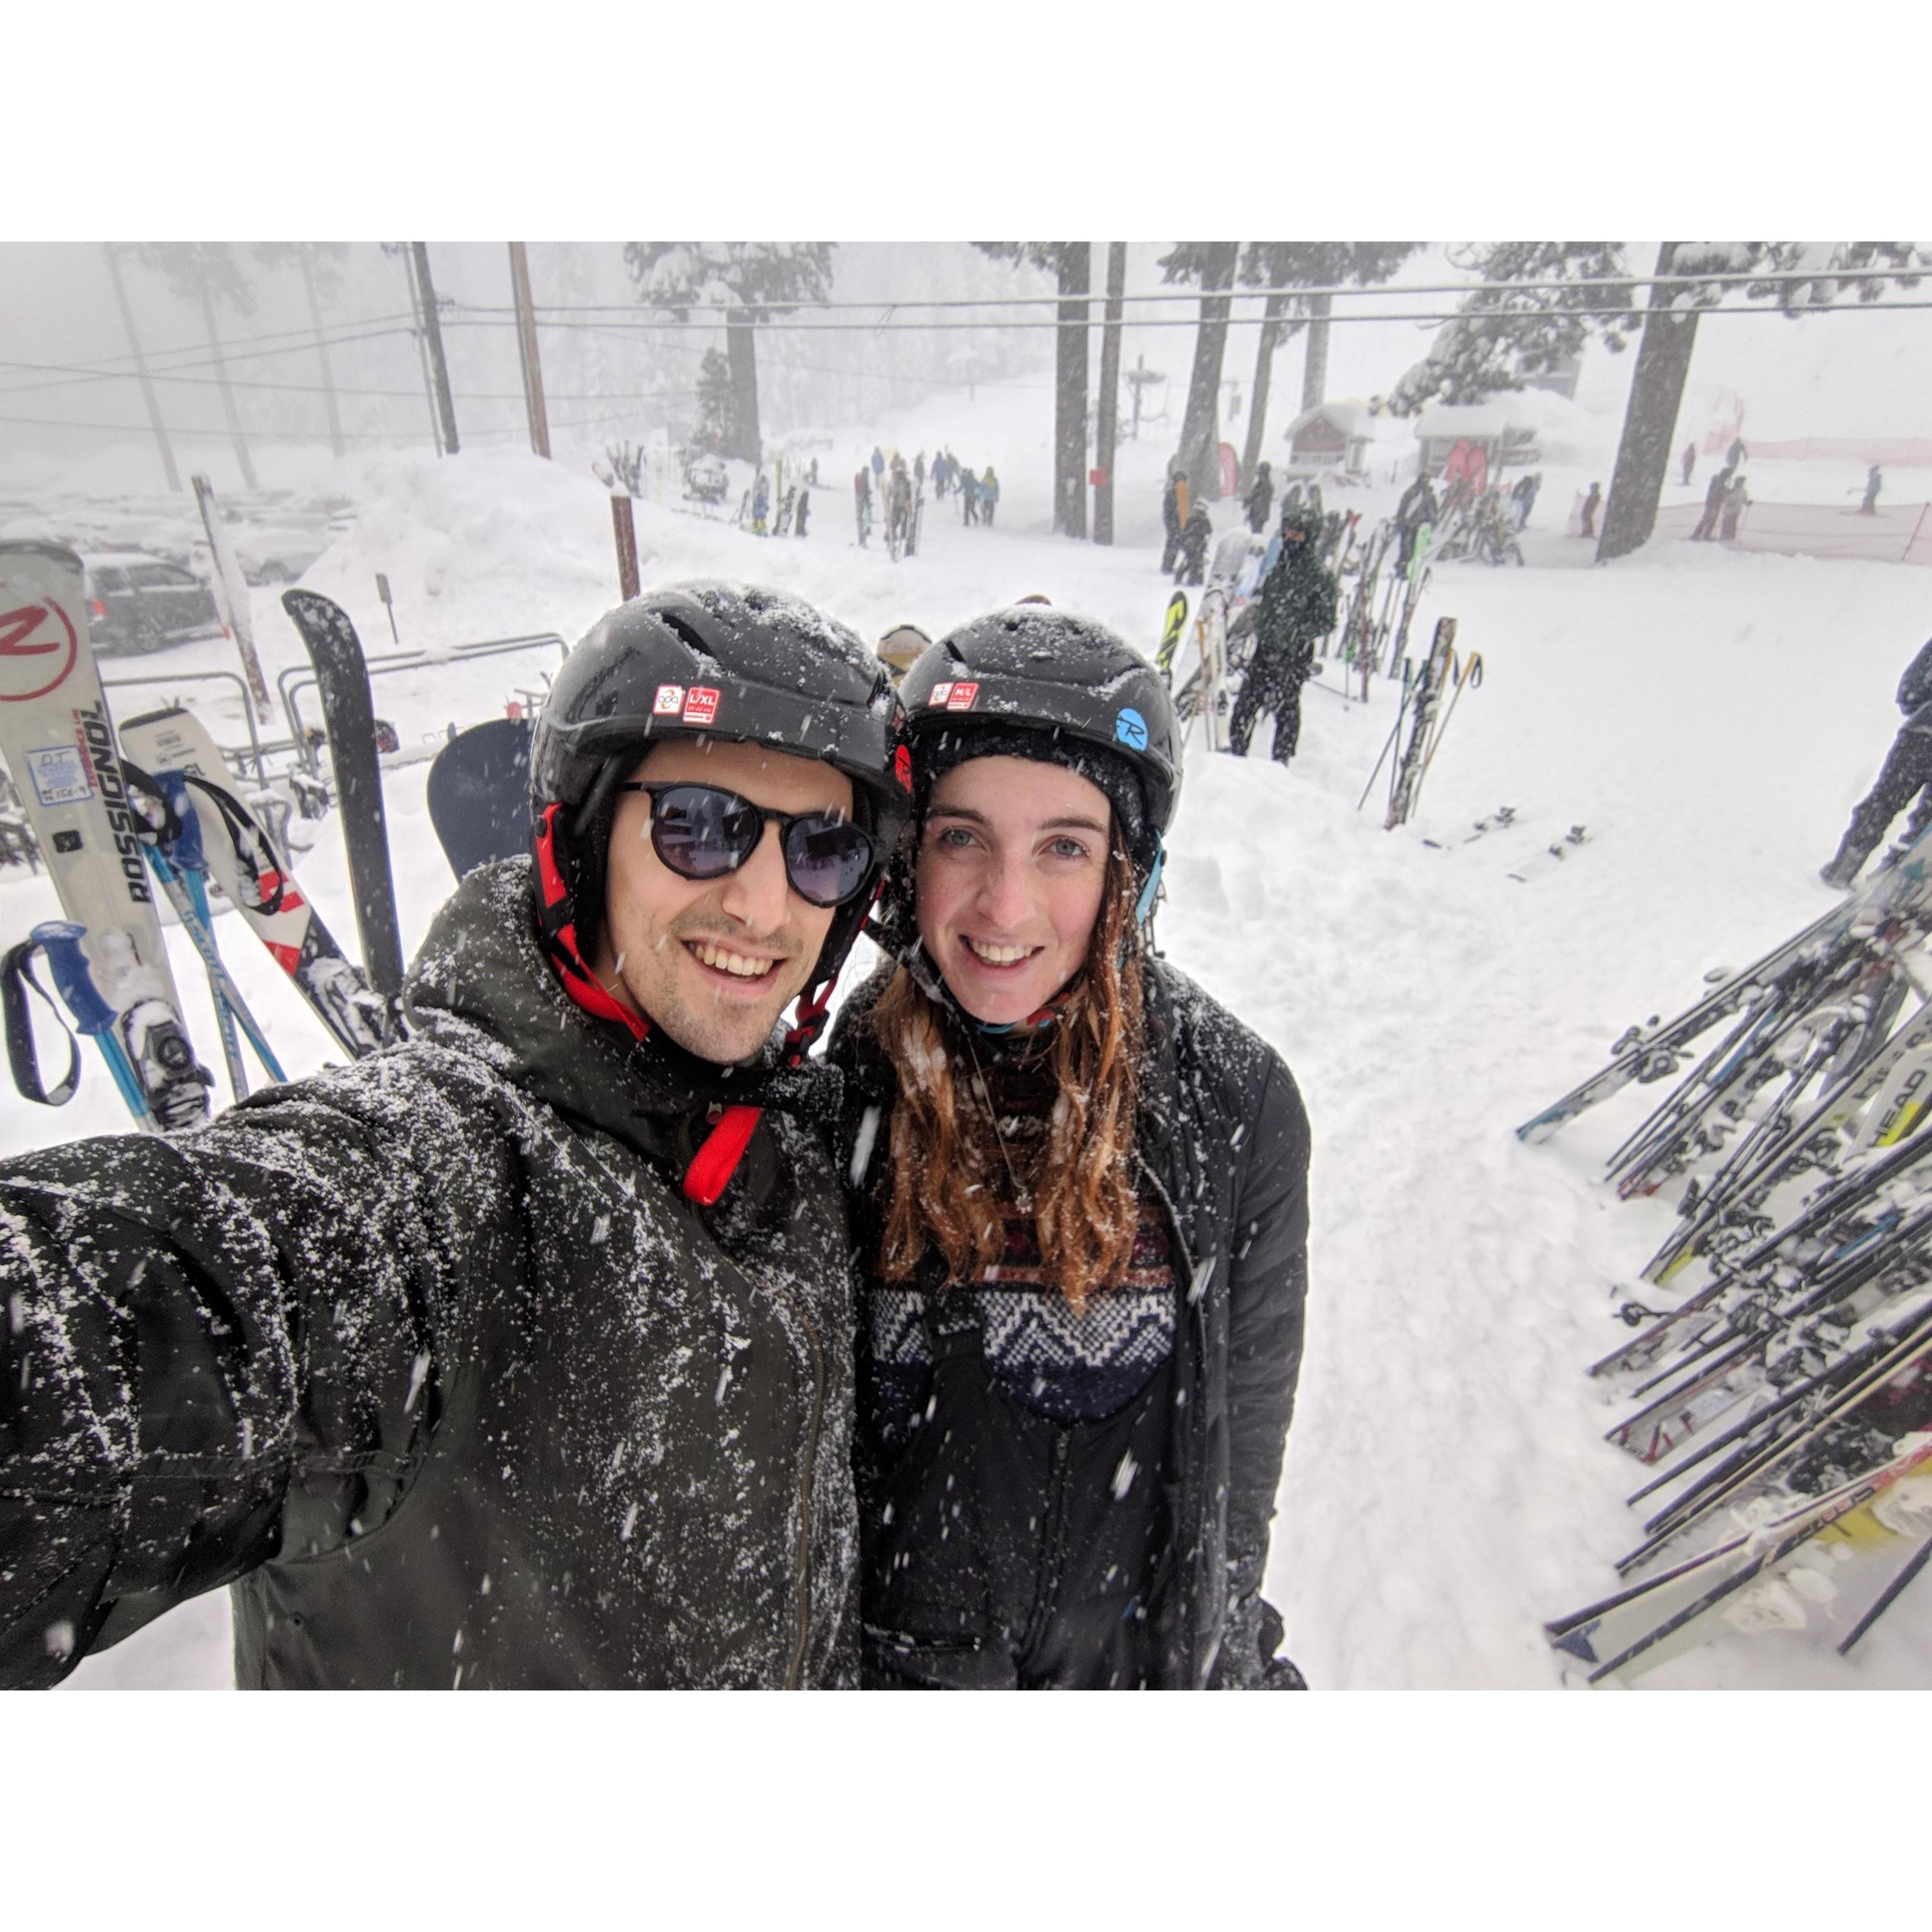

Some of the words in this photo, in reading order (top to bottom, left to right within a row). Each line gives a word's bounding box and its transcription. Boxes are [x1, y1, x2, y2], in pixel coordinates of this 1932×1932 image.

[690, 694, 715, 706] L/XL
[955, 688, 971, 697] M/L
[81, 701, 151, 902] ROSSIGNOL
[1867, 1068, 1926, 1147] HEAD
